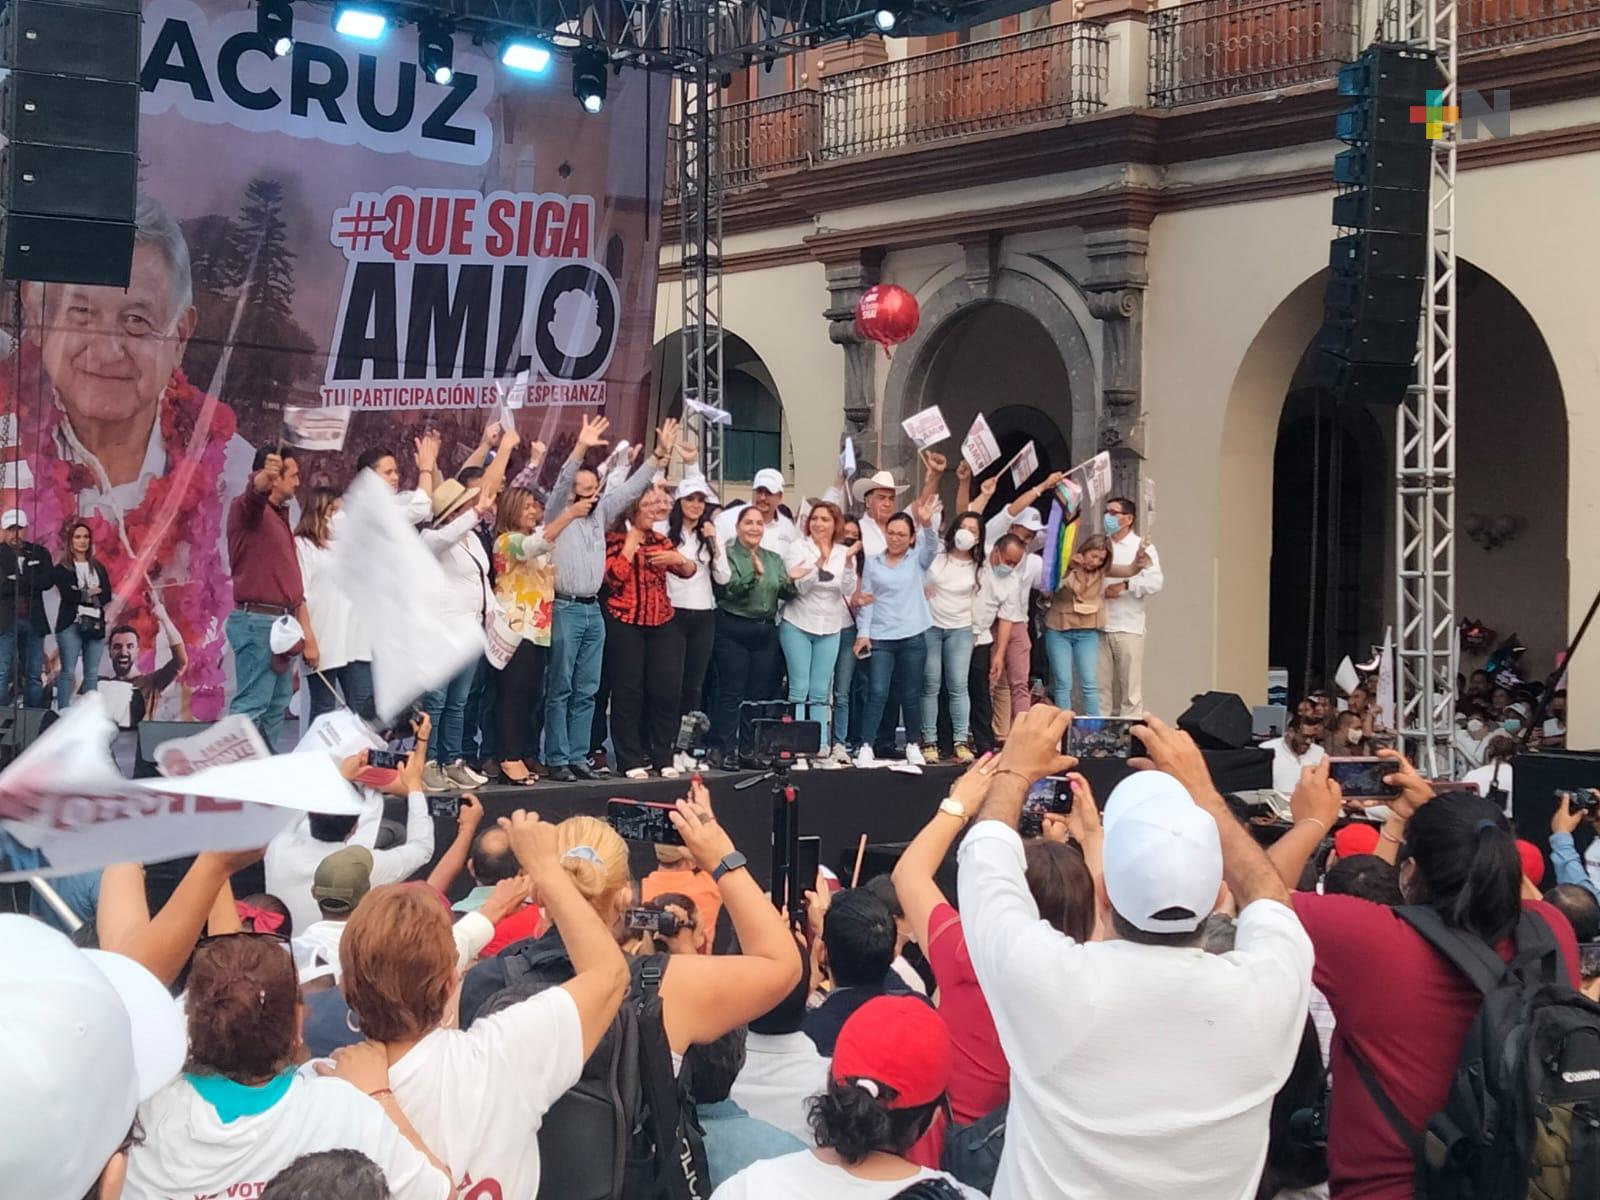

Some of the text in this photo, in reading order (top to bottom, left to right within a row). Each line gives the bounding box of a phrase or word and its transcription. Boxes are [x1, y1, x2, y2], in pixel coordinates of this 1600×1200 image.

[140, 18, 478, 145] ACRUZ
[337, 194, 590, 260] #QUE SIGA
[333, 261, 616, 381] AMLO
[323, 387, 345, 408] TU
[353, 383, 475, 407] PARTICIPACIÓN
[481, 386, 498, 404] ES
[527, 383, 606, 403] ESPERANZA
